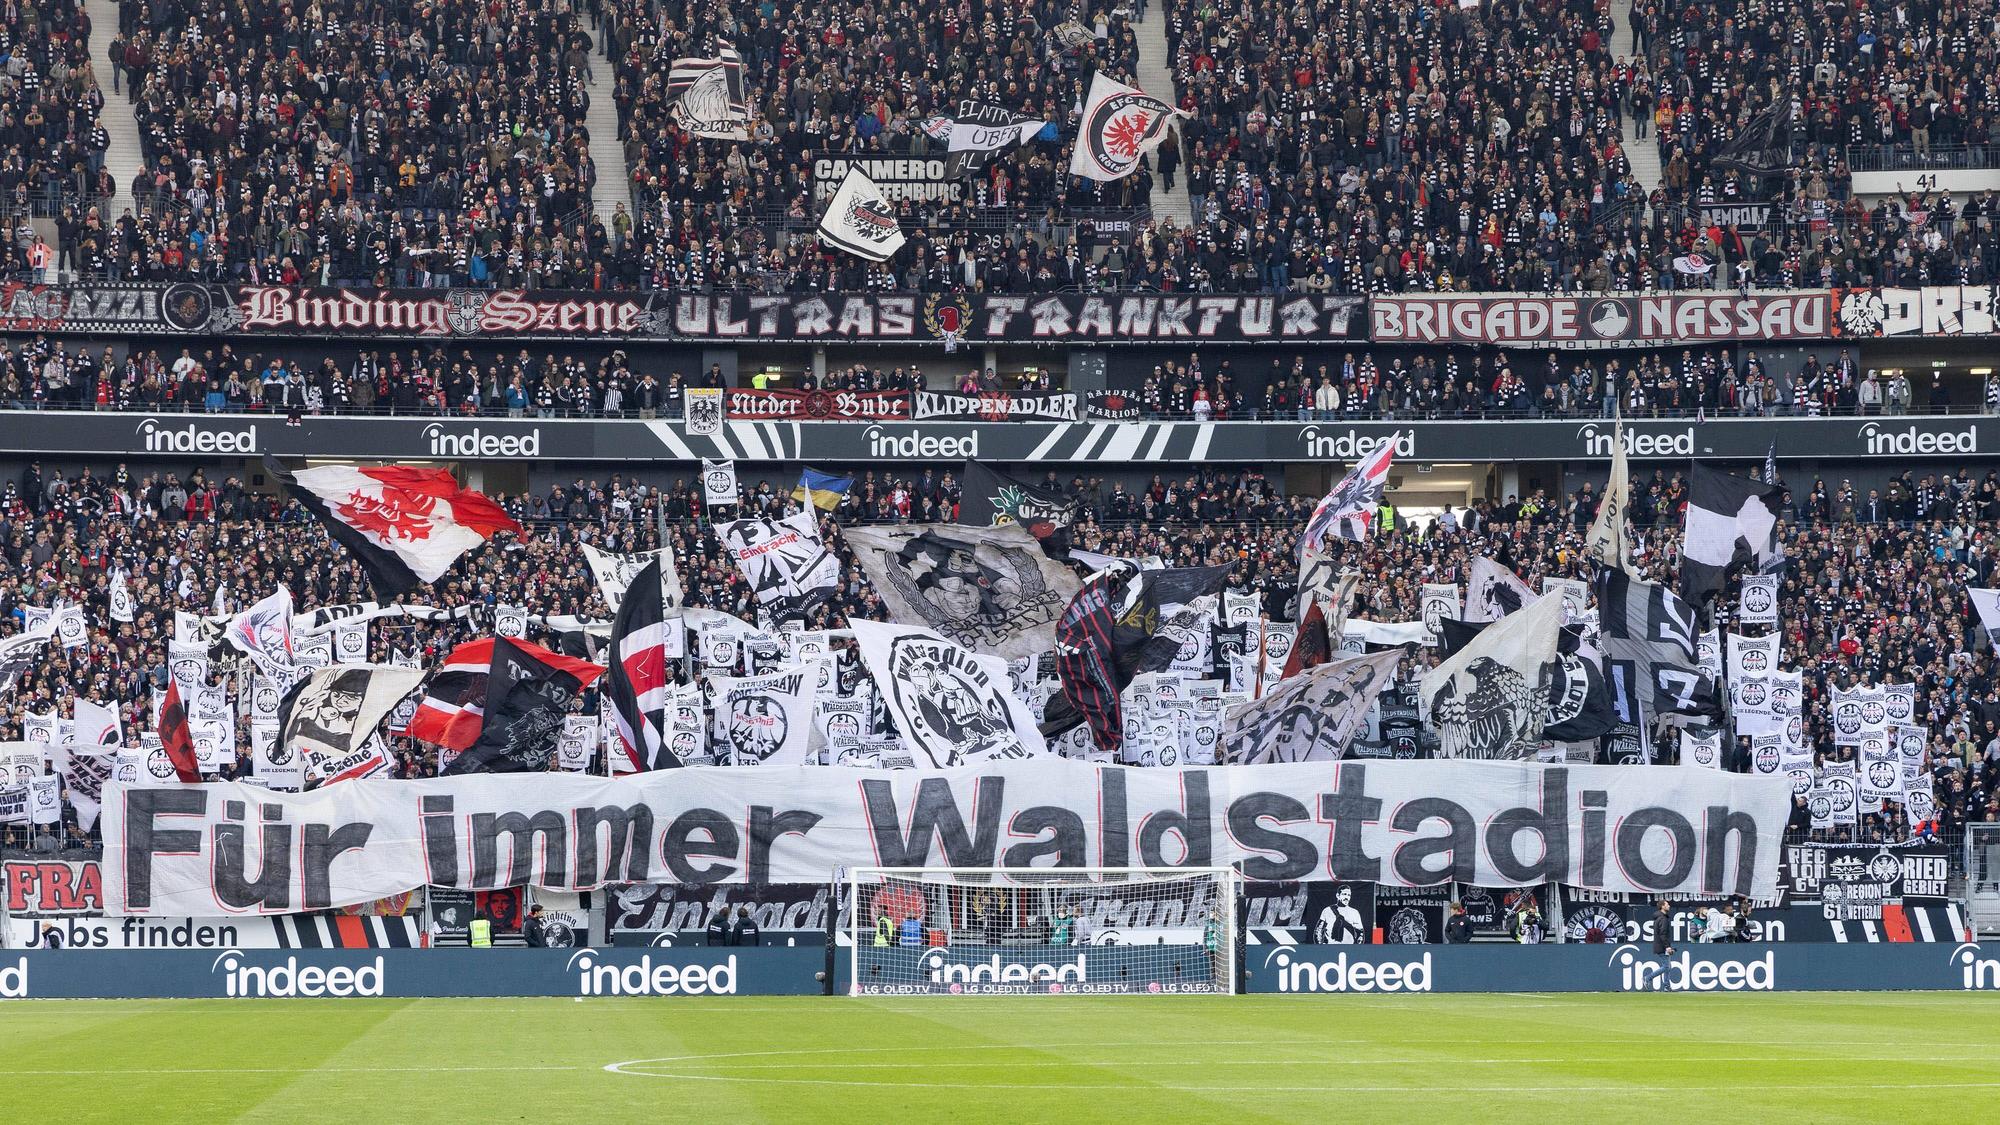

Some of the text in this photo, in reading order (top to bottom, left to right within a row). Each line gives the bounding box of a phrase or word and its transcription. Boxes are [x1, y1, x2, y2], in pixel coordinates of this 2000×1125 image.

[972, 126, 1022, 147] ÜBER
[1916, 174, 1937, 188] 41
[240, 286, 451, 334] Binding
[481, 289, 642, 332] Szene
[675, 295, 1364, 336] ULTRAS FRANKFURT
[1373, 296, 1824, 342] BRIGADE NASSAU
[730, 392, 903, 417] Nieder Bube
[915, 391, 1077, 420] KLIPPENADLER
[144, 424, 256, 454] indeed
[430, 426, 539, 456] indeed
[871, 429, 978, 457] indeed
[1867, 424, 1977, 455] indeed
[738, 531, 799, 560] Eintracht
[1738, 641, 1771, 651] WALDSTADION
[823, 702, 864, 713] WALDSTADION
[322, 749, 373, 773] Szene
[859, 744, 901, 754] WALDSTADION
[1353, 743, 1393, 756] WALDSTADION
[881, 759, 915, 769] WALDSTADION
[1823, 768, 1855, 779] WALDSTADION
[122, 762, 1758, 914] Für immer Waldstadion
[1903, 857, 1948, 881] RIED
[1795, 878, 1820, 892] 64
[1846, 884, 1882, 899] REGION
[1903, 880, 1947, 895] GEBIET
[615, 884, 830, 930] Eintracht
[1823, 903, 1882, 920] 61 WETTERAU
[121, 917, 238, 947] finden
[226, 953, 384, 996] indeed
[580, 953, 737, 996] indeed
[929, 953, 1086, 983] indeed
[1278, 952, 1432, 993] indeed
[864, 985, 930, 994] LG OLED TV
[964, 984, 1030, 994] LG OLED TV
[1063, 983, 1129, 993] LG OLED TV
[1162, 983, 1177, 993] LG
